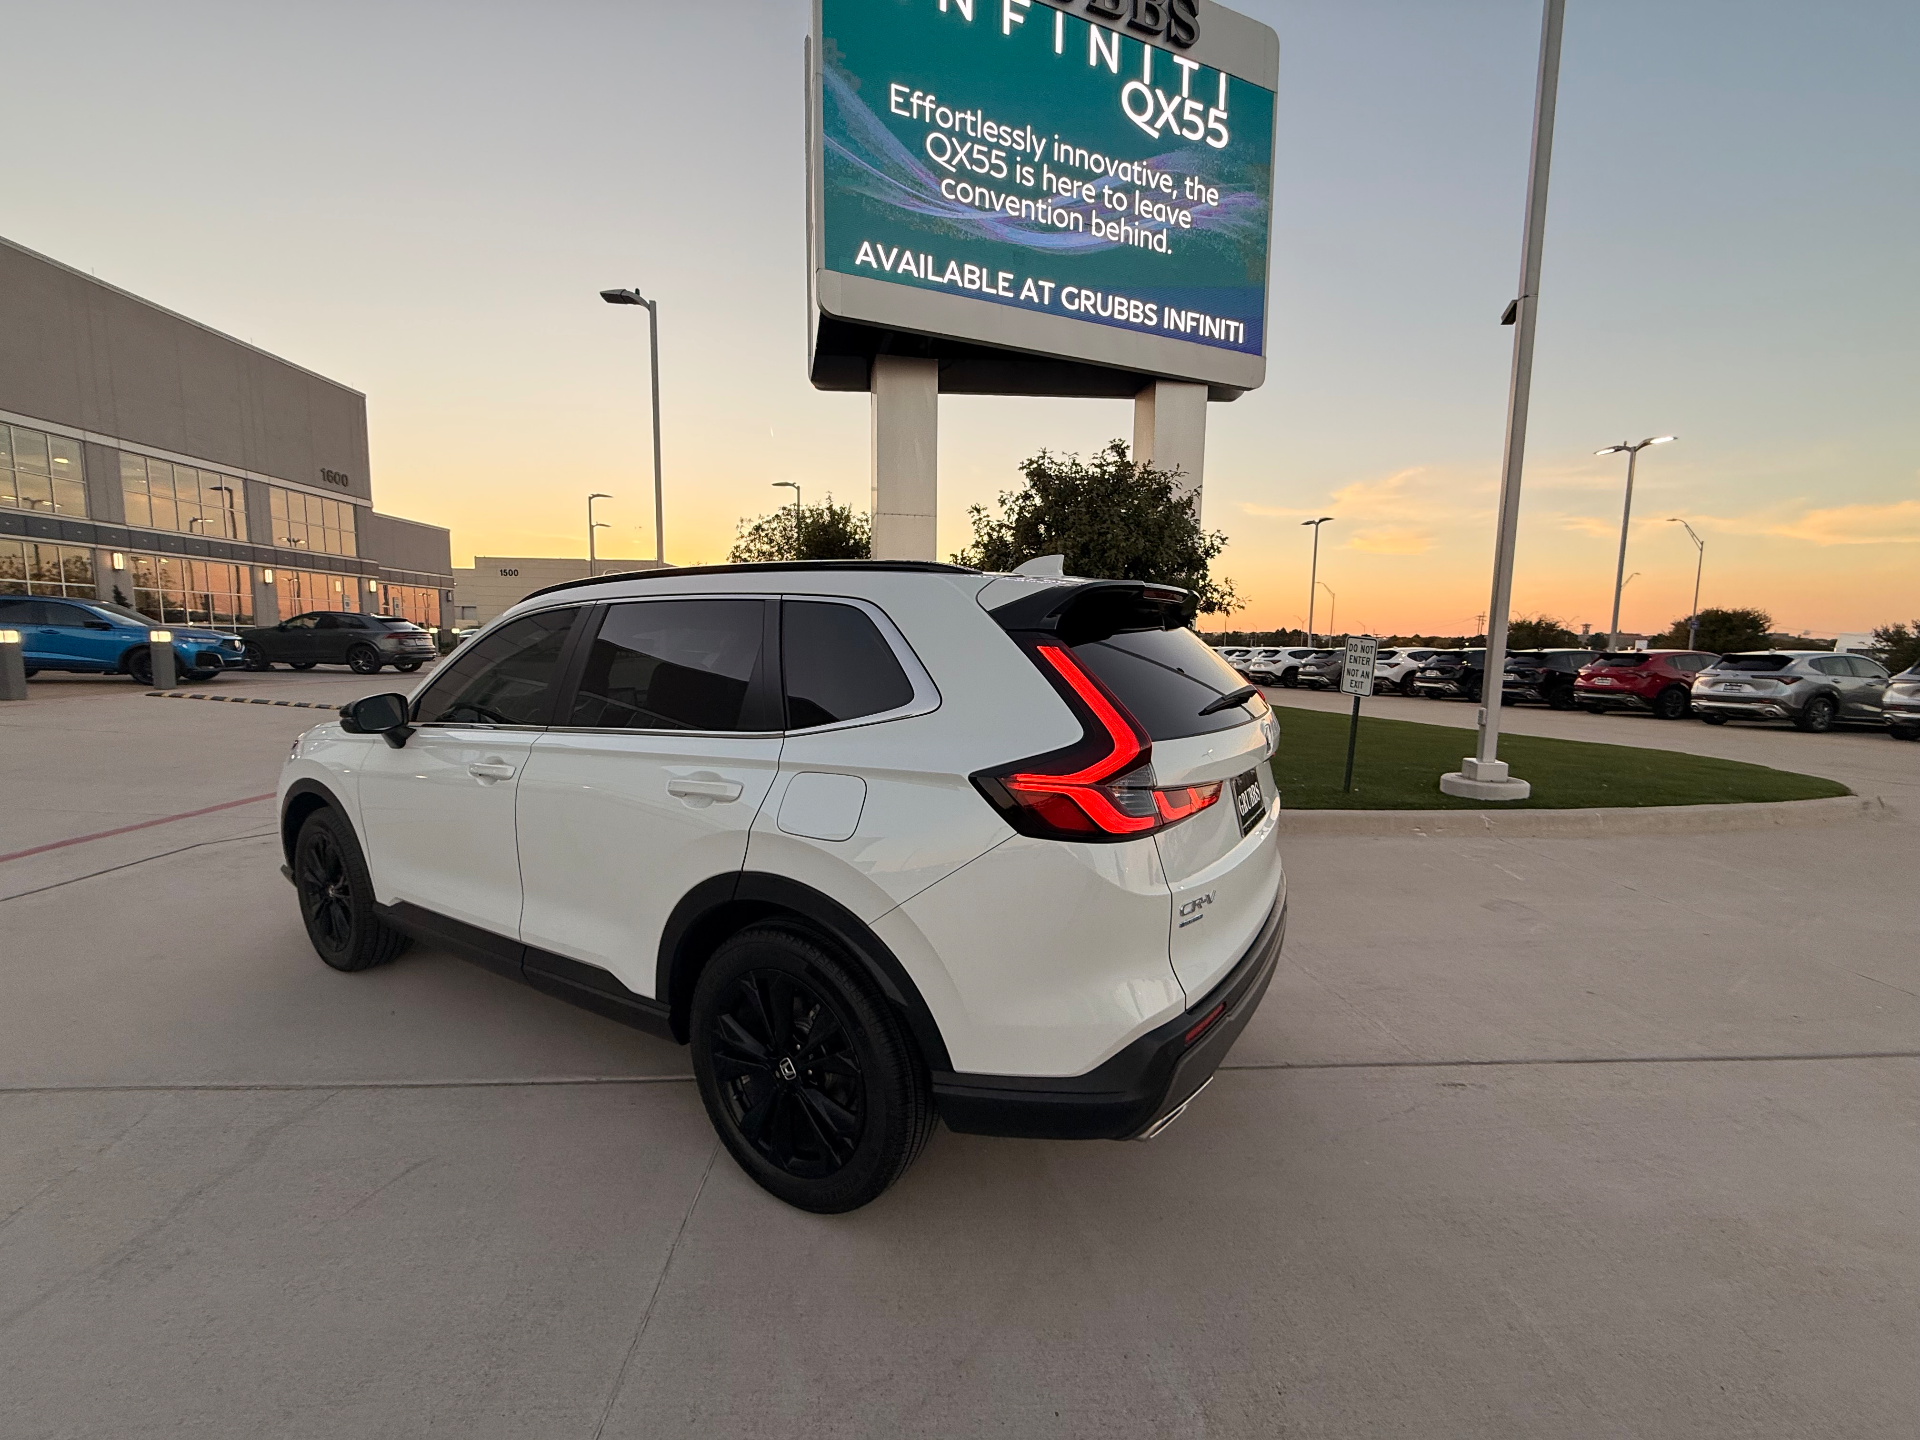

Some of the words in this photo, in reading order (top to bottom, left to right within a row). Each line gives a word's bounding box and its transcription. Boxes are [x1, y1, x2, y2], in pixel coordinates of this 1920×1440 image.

[1121, 81, 1229, 149] QX55
[890, 83, 1047, 161] Effortlessly
[1053, 134, 1179, 200] innovative,
[1184, 176, 1220, 207] the
[926, 132, 1008, 179] QX55
[1016, 156, 1035, 187] is
[1042, 163, 1097, 204] here
[1102, 184, 1129, 212] to
[1134, 189, 1193, 229] leave
[941, 178, 1084, 233] convention
[1091, 209, 1173, 255] behind.
[854, 241, 1015, 298] AVAILABLE
[1019, 277, 1056, 305] AT
[1061, 286, 1159, 327] GRUBBS
[1163, 306, 1245, 345] INFINITI
[320, 468, 348, 487] 1600
[499, 568, 519, 577] 1500
[1349, 643, 1358, 653] DO
[1360, 645, 1374, 654] NOT
[1349, 655, 1371, 666] ENTER
[1347, 668, 1360, 677] NOT
[1360, 670, 1370, 679] AN
[1349, 680, 1364, 689] EXIT
